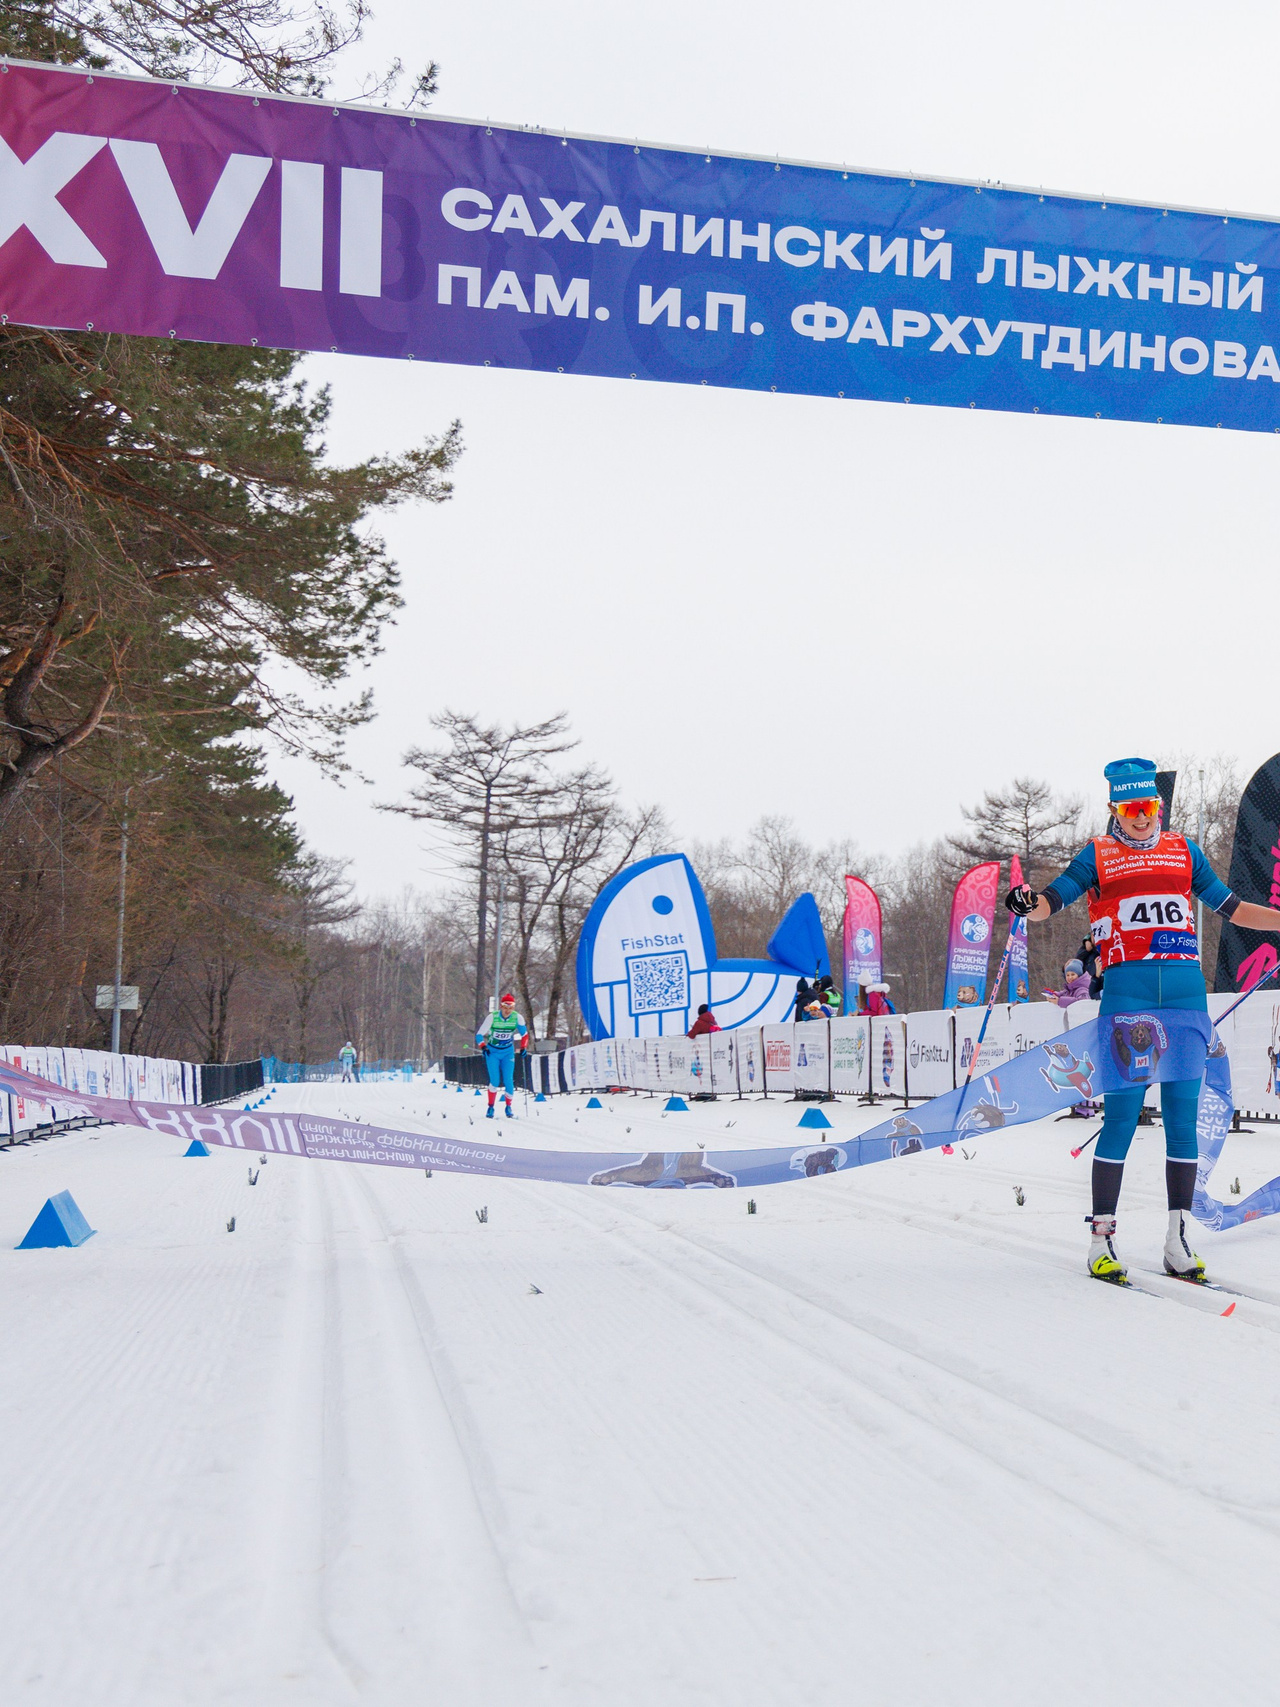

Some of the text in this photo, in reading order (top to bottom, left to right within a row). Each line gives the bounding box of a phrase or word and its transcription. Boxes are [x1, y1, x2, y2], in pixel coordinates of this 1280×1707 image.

[441, 187, 953, 280] САХАЛИНСКИЙ
[977, 247, 1264, 313] ЛЫЖНЫЙ
[438, 264, 610, 322] ПАМ.
[638, 285, 765, 336] И.П.
[1105, 860, 1186, 875] ЛЫЖНЫЙ МАРАФОН
[1128, 853, 1187, 861] САХАЛИНСКИЙ
[1130, 901, 1184, 925] 416
[621, 933, 684, 951] FishStat
